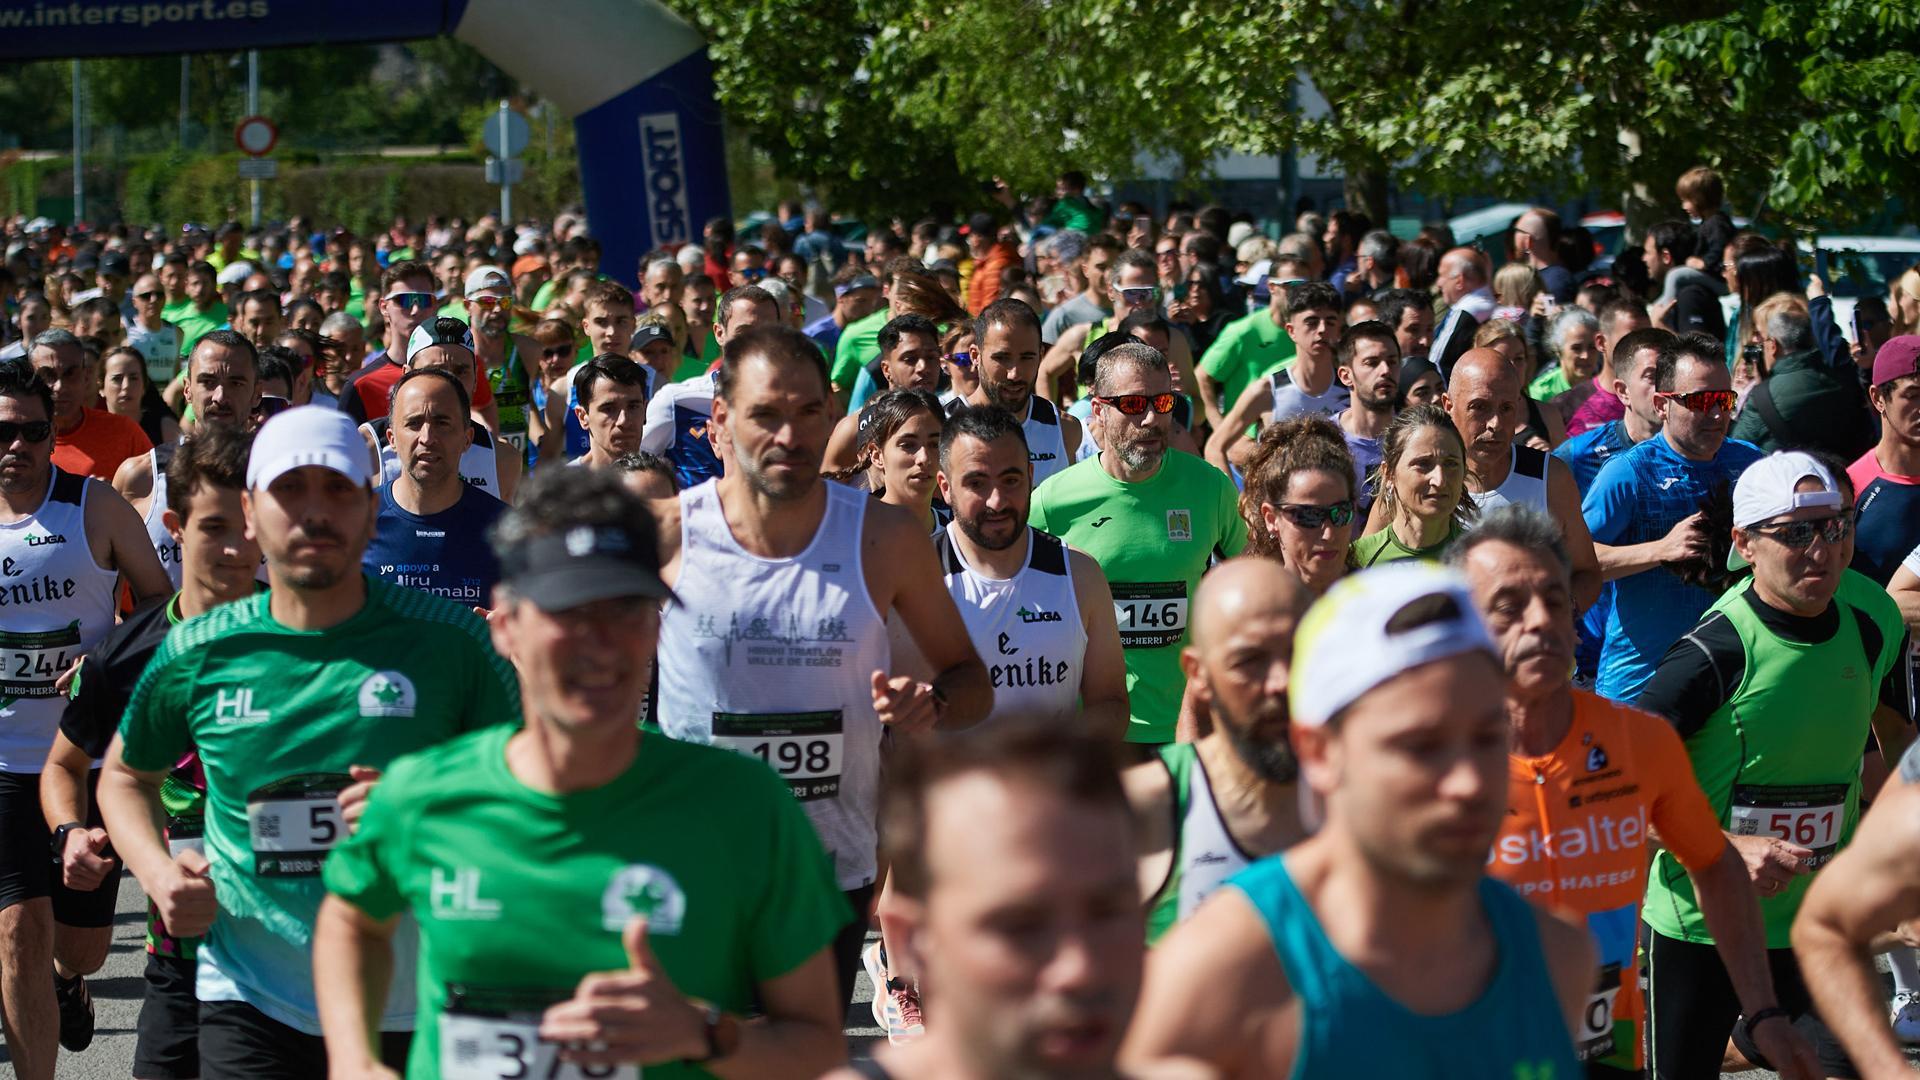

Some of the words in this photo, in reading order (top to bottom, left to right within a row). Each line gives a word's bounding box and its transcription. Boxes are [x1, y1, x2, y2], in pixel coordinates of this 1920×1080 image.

[643, 126, 688, 243] SPORT
[464, 475, 487, 487] UGA
[28, 534, 67, 547] LUGA
[380, 565, 394, 575] yo
[396, 564, 430, 573] apoyo
[432, 564, 440, 572] a
[1022, 611, 1062, 624] LUGA
[1123, 603, 1179, 628] 146
[14, 650, 72, 678] 244
[787, 657, 802, 666] DE
[216, 688, 270, 718] HL
[752, 740, 830, 774] 198
[309, 806, 338, 845] 5
[1769, 810, 1834, 845] 561
[430, 866, 502, 912] HL
[1515, 880, 1554, 896] PO
